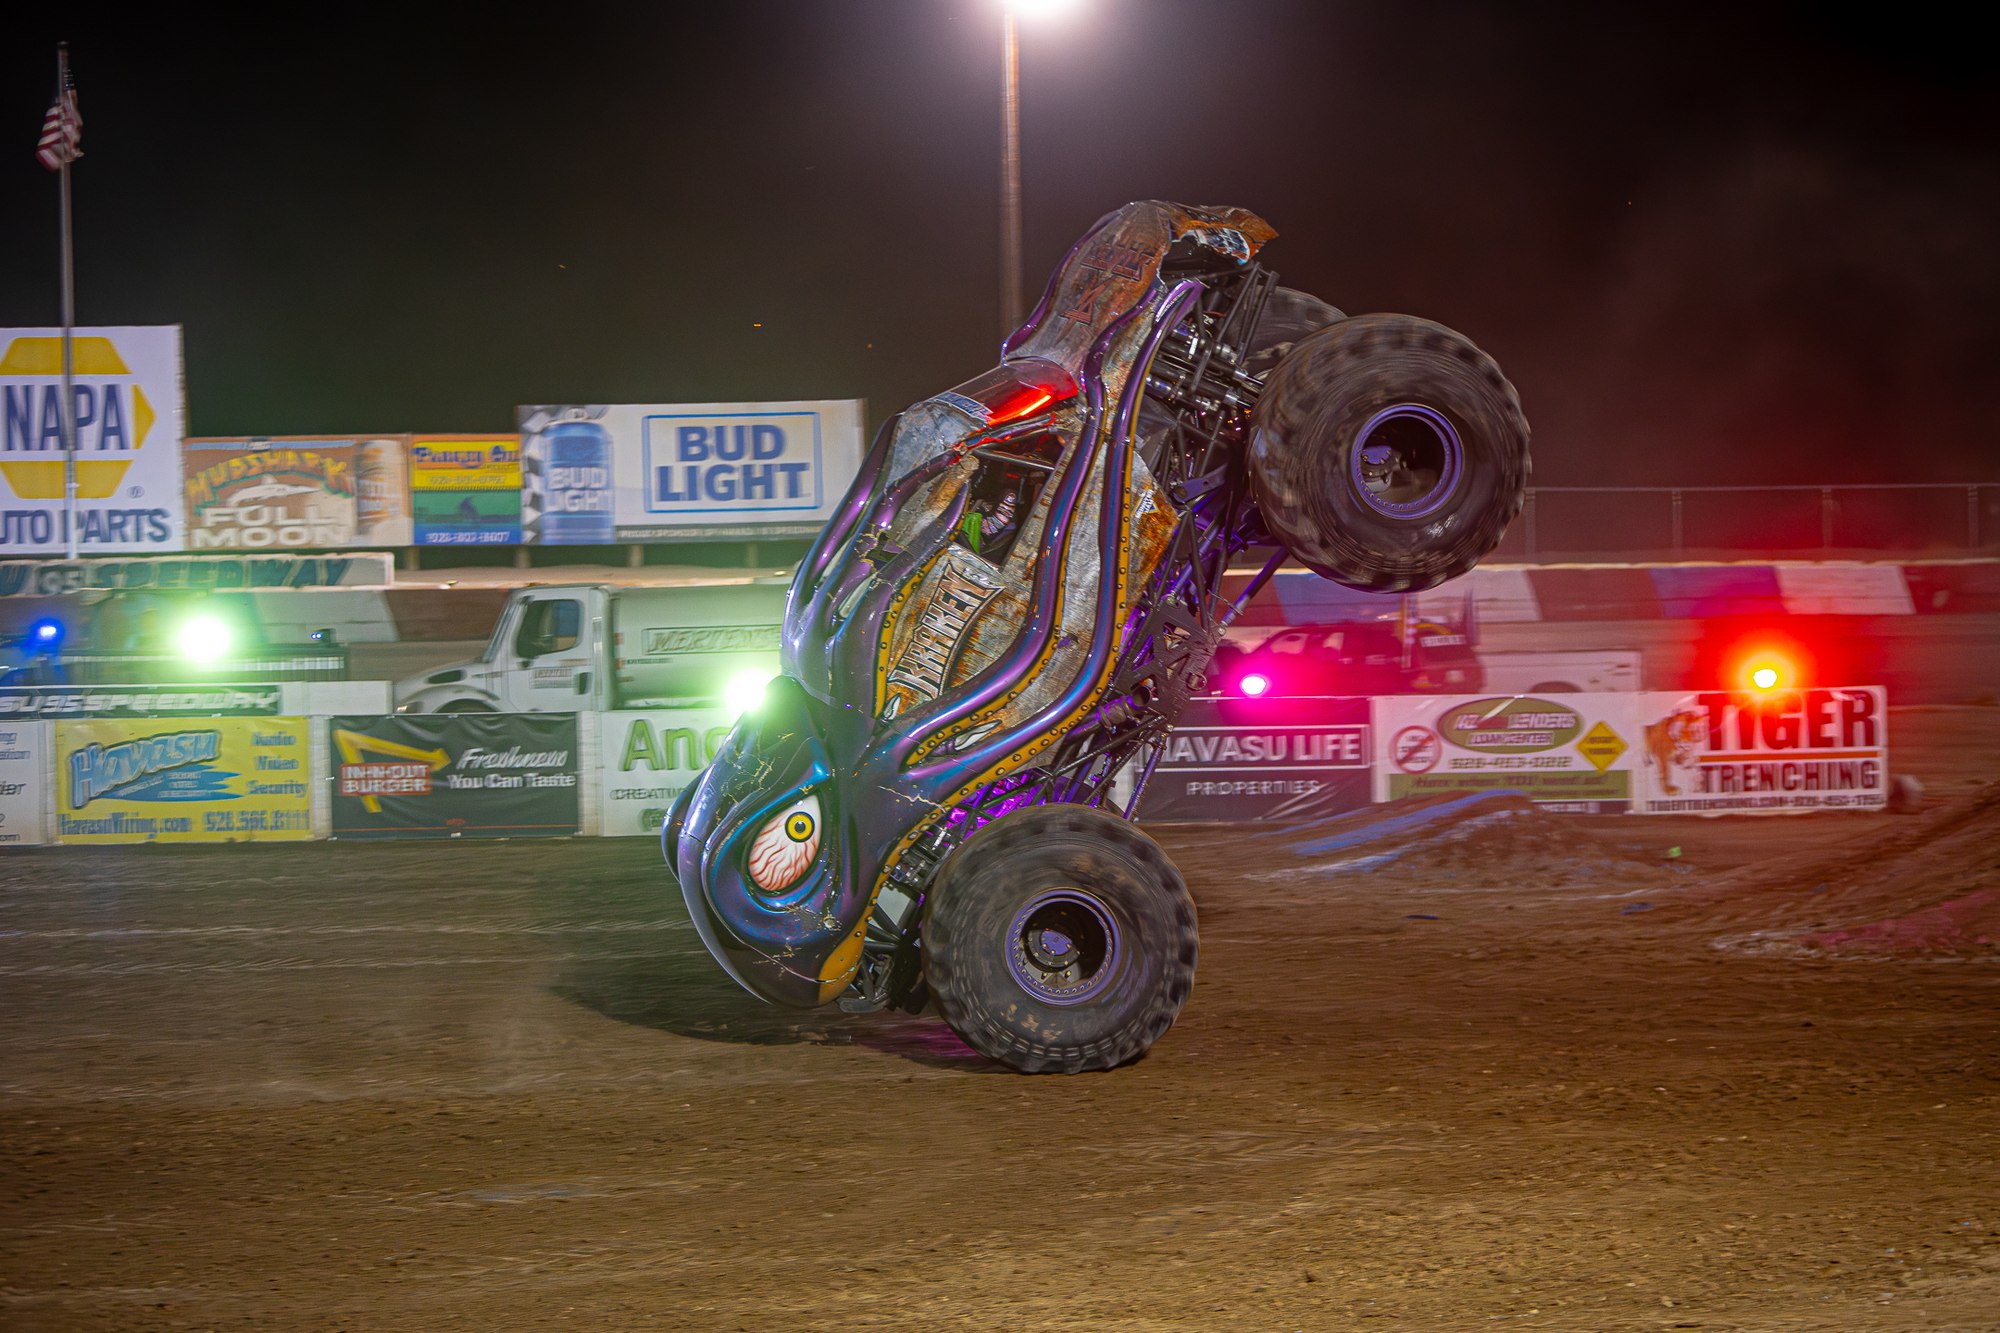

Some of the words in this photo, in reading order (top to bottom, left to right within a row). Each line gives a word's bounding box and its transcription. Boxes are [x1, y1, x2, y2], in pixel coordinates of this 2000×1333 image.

[4, 384, 131, 451] NAPA
[676, 425, 788, 462] BUD
[655, 463, 811, 501] LIGHT
[192, 526, 352, 548] MOON
[887, 561, 1004, 700] KRAKEN
[1698, 689, 1877, 751] TIGER
[1293, 734, 1360, 761] LIFE
[343, 779, 429, 793] BURGER
[447, 774, 483, 789] You
[485, 773, 523, 788] Can
[524, 772, 577, 788] Taste
[1186, 780, 1320, 796] PROPERTIES
[1700, 761, 1881, 793] TRENCHING
